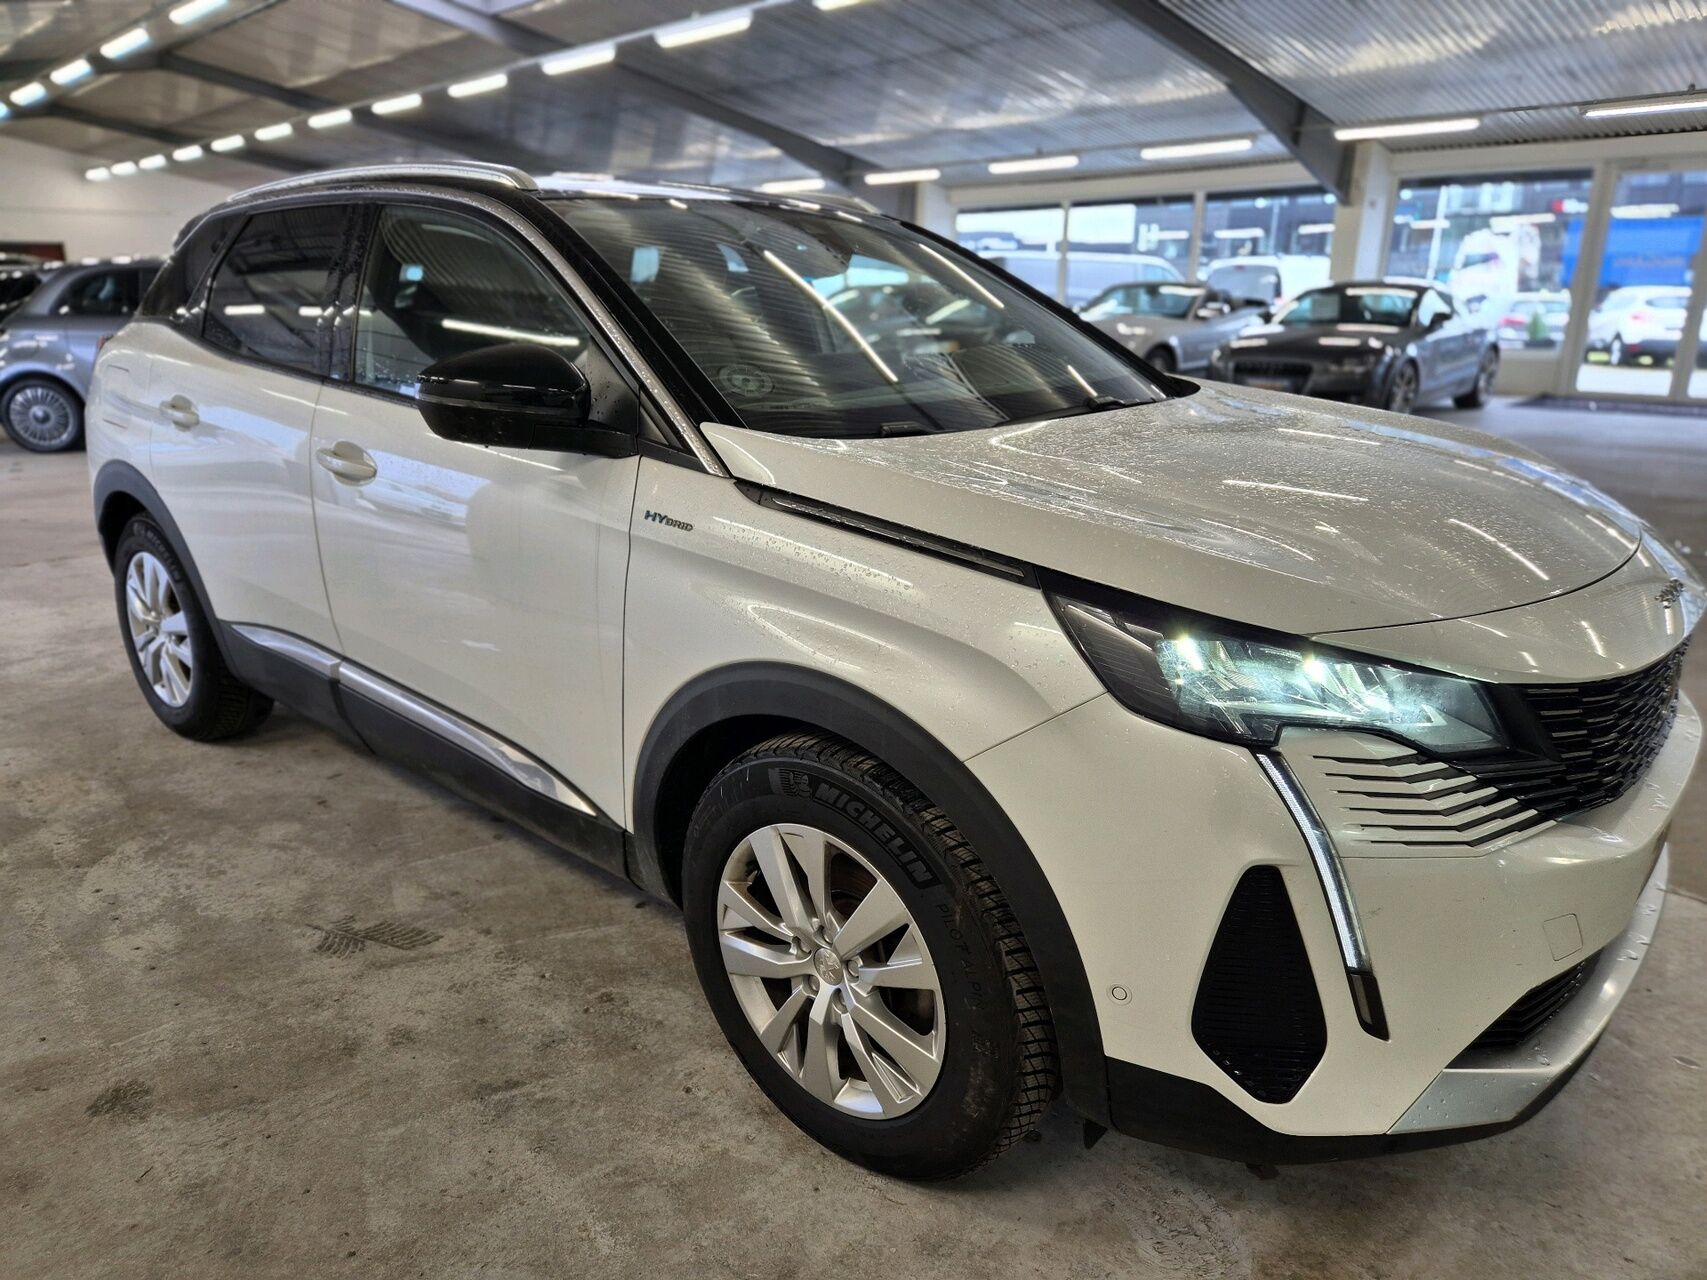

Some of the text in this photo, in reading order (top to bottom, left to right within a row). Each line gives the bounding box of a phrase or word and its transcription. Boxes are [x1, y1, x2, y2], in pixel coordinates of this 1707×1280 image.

[644, 510, 693, 532] HYBRID
[815, 783, 934, 882] MICHELIN
[936, 903, 971, 955] PILOT
